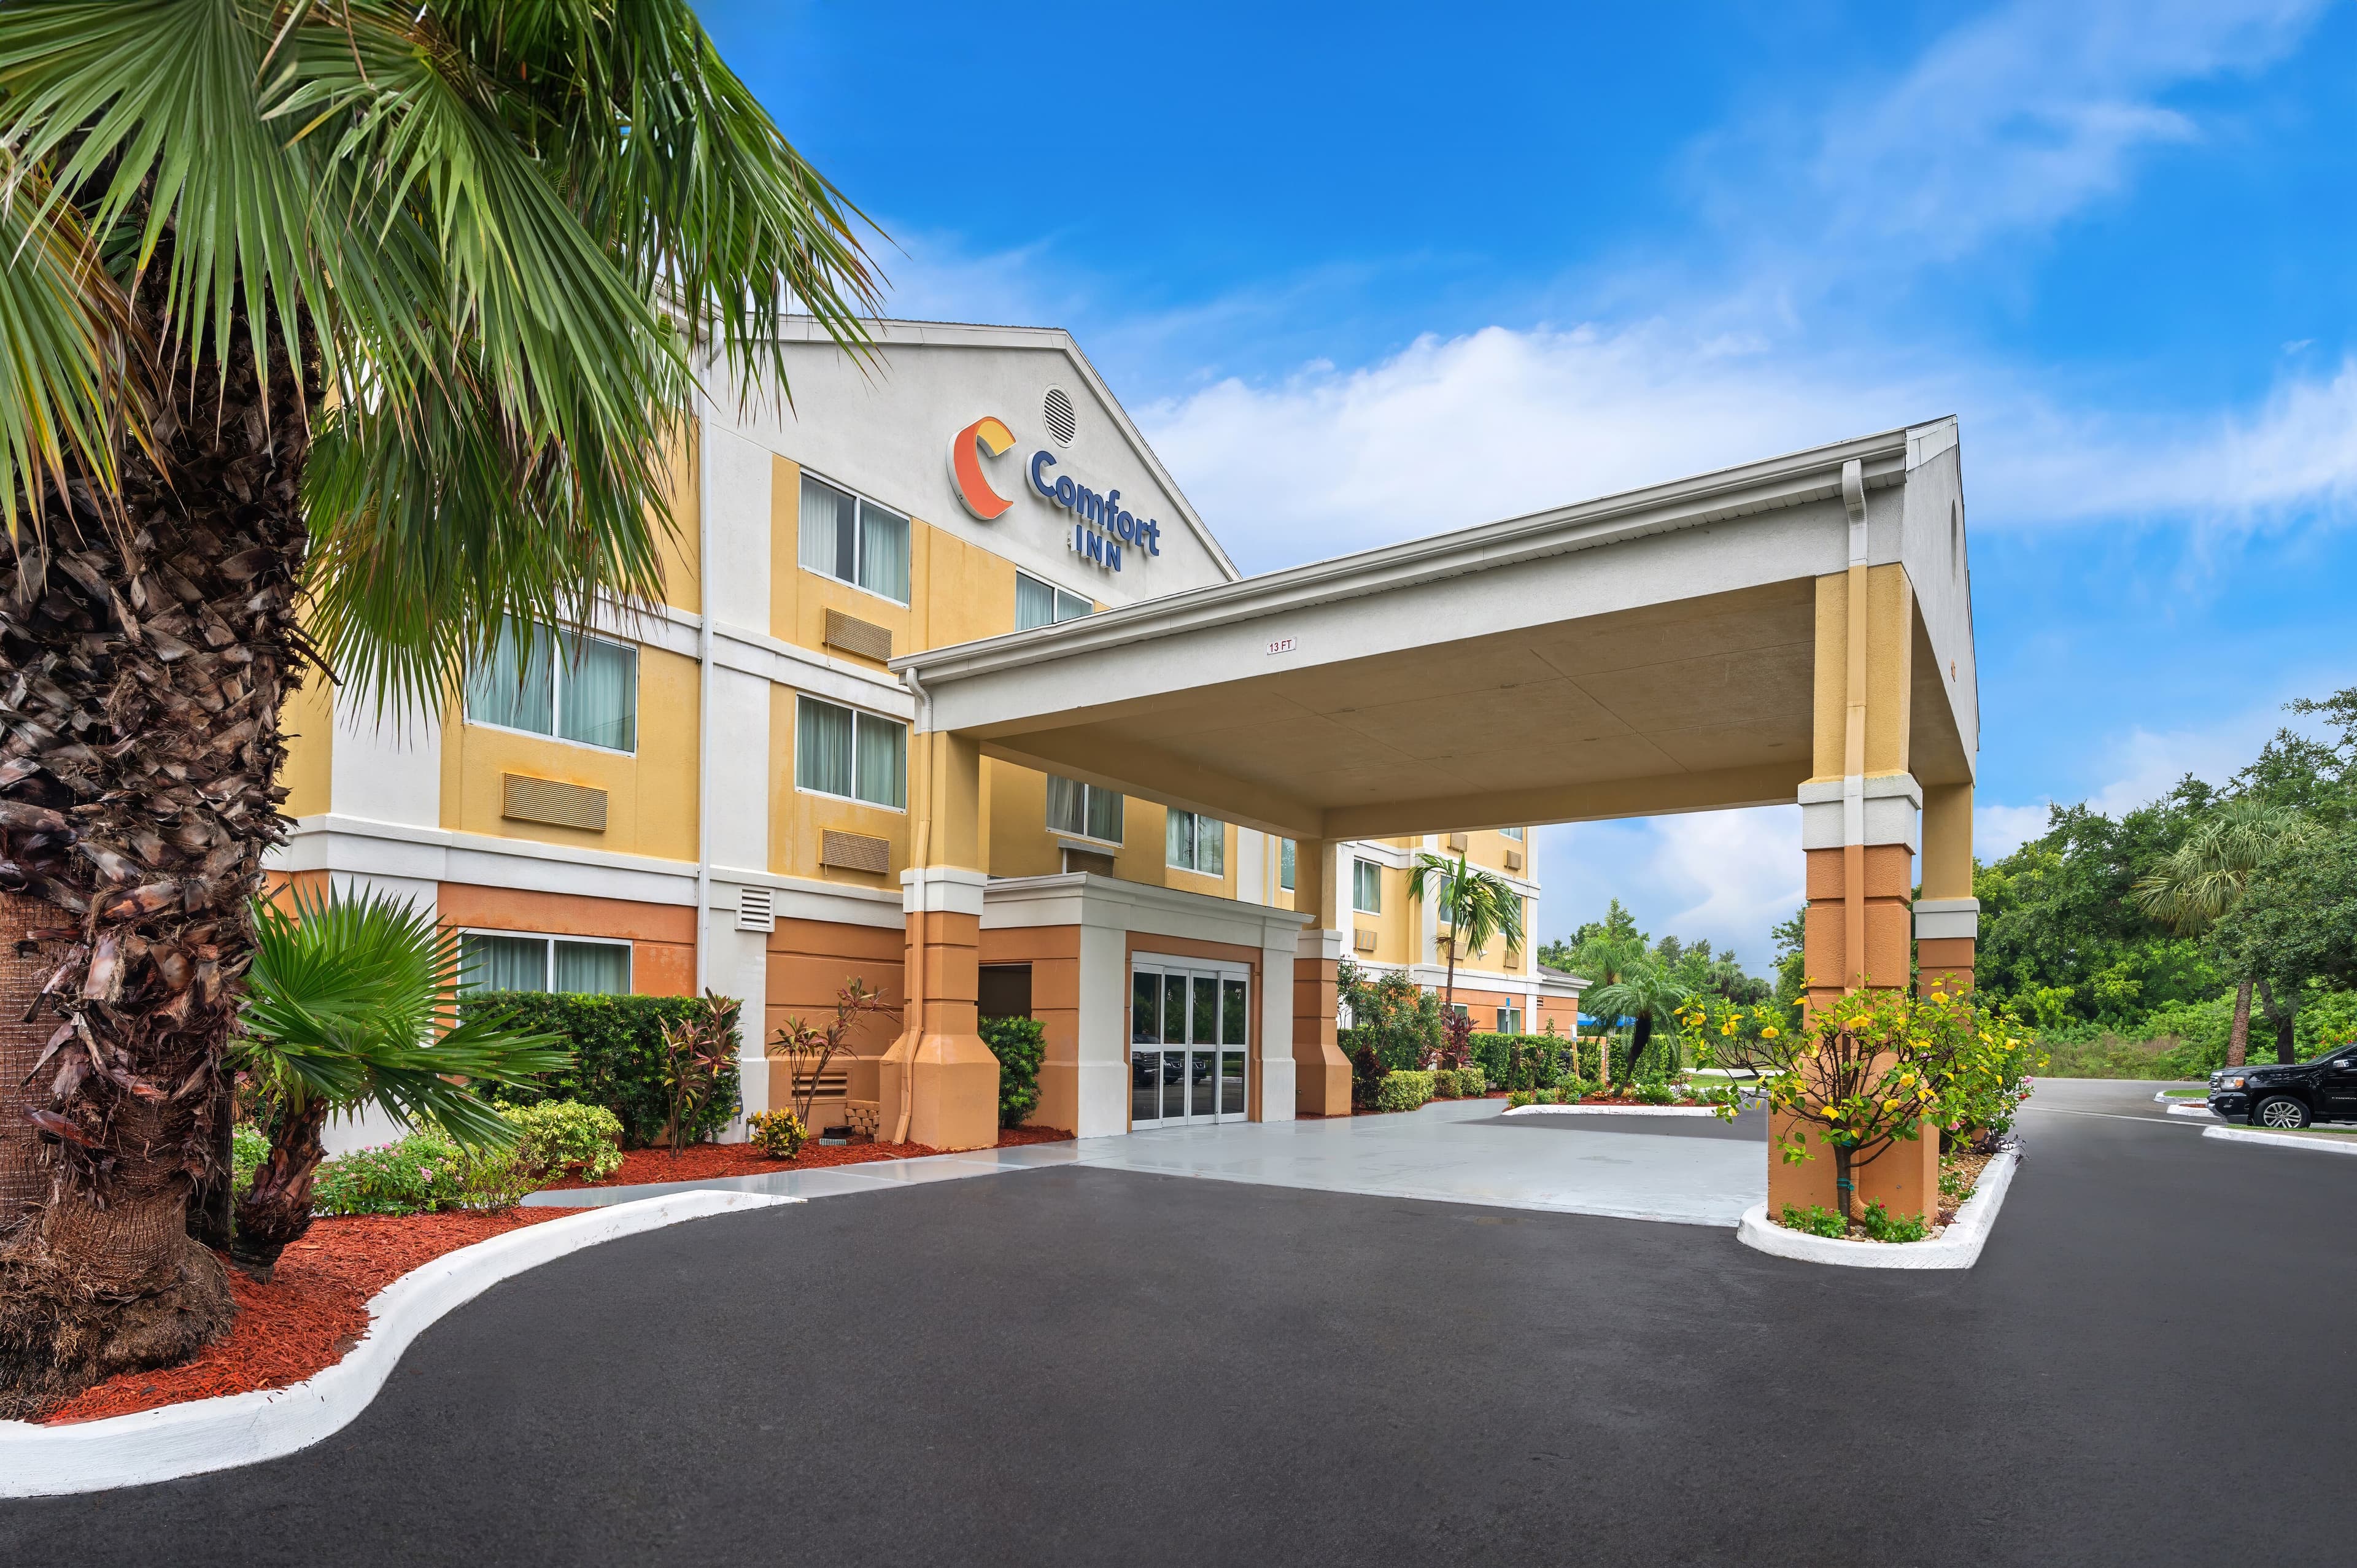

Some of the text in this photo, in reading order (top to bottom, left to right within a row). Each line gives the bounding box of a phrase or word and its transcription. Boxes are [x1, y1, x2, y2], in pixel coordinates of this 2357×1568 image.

[1029, 450, 1160, 556] Comfort
[1073, 524, 1121, 571] INN
[1269, 639, 1292, 652] 13 FT
